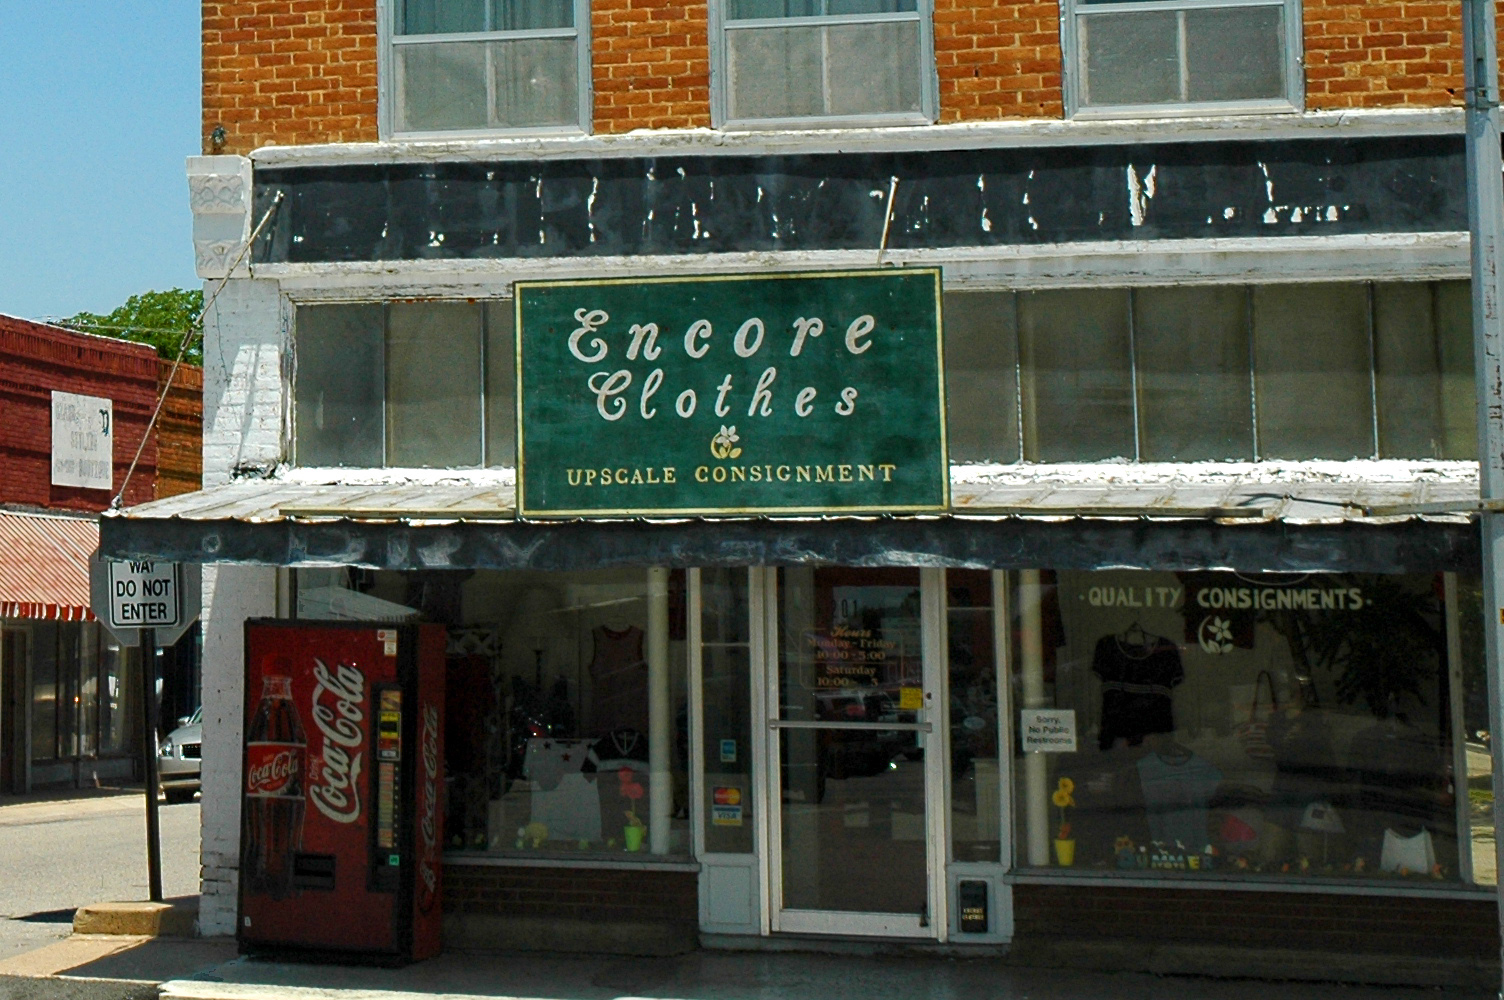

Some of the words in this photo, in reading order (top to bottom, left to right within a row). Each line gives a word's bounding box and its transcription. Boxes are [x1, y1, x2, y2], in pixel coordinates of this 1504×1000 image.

[567, 307, 875, 363] Encore
[588, 367, 858, 421] Clothes
[567, 467, 677, 486] UPSCALE
[695, 463, 896, 484] CONSIGNMENT
[129, 561, 155, 573] WAY
[116, 580, 136, 597] DO
[143, 579, 170, 596] NOT
[1088, 587, 1182, 607] QUALITY
[1196, 587, 1364, 610] CONSIGNMENTS
[122, 603, 167, 620] ENTER
[831, 624, 872, 638] Hours
[808, 638, 851, 649] Monday
[860, 638, 896, 649] Friday
[826, 665, 876, 676] Saturday
[1029, 725, 1041, 733] No
[1043, 725, 1070, 733] Public
[309, 657, 365, 824] Coca-Cola
